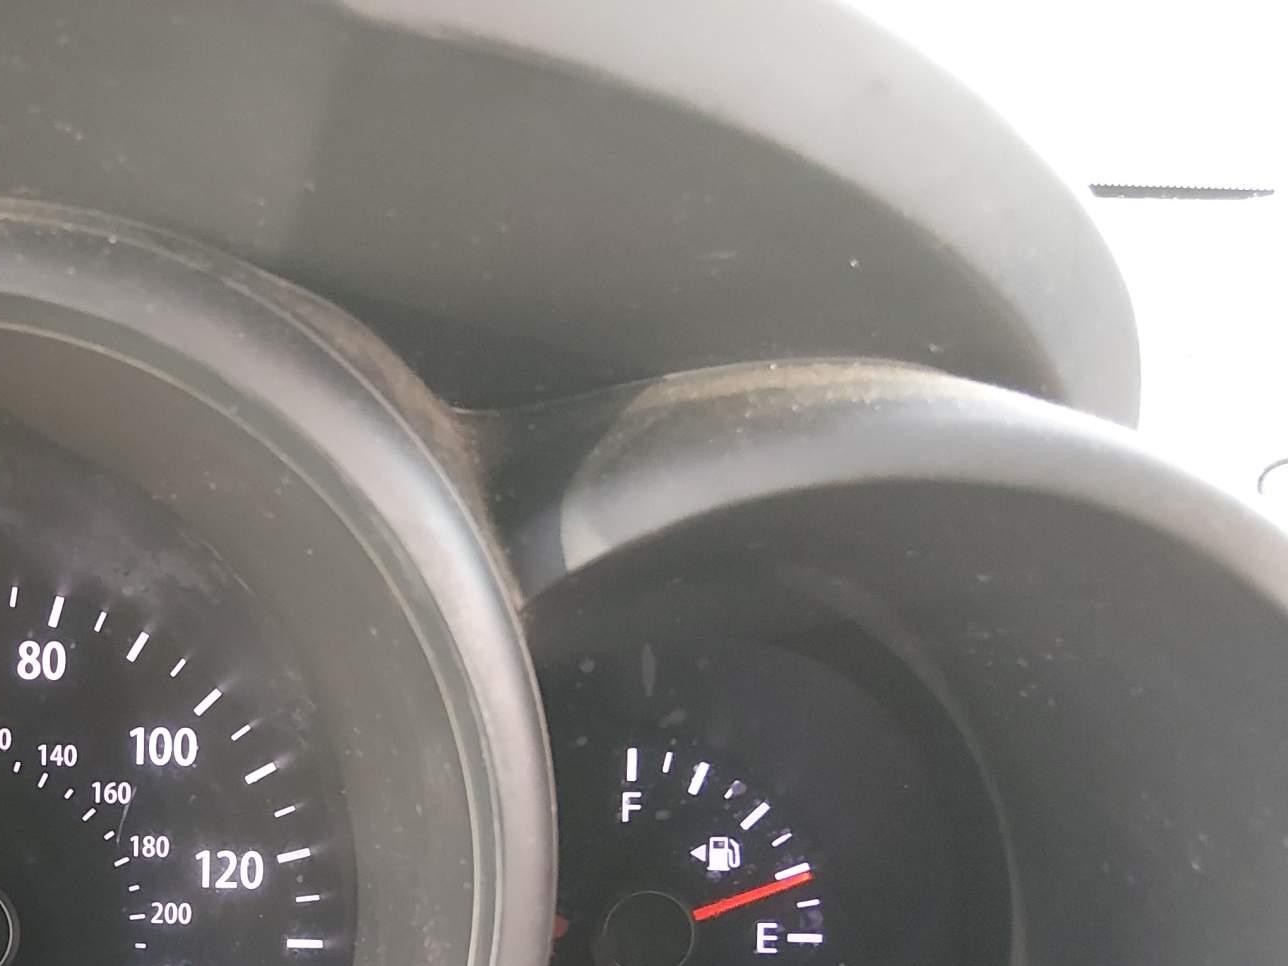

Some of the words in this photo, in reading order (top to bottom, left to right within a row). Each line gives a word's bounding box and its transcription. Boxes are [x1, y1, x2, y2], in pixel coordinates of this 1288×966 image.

[17, 641, 66, 680] 80
[38, 745, 77, 766] 140
[130, 727, 199, 768] 100
[92, 782, 133, 808] 160
[622, 792, 641, 822] F
[130, 836, 169, 857] 180
[195, 848, 264, 894] 120
[151, 902, 192, 924] 200
[756, 923, 778, 953] E
